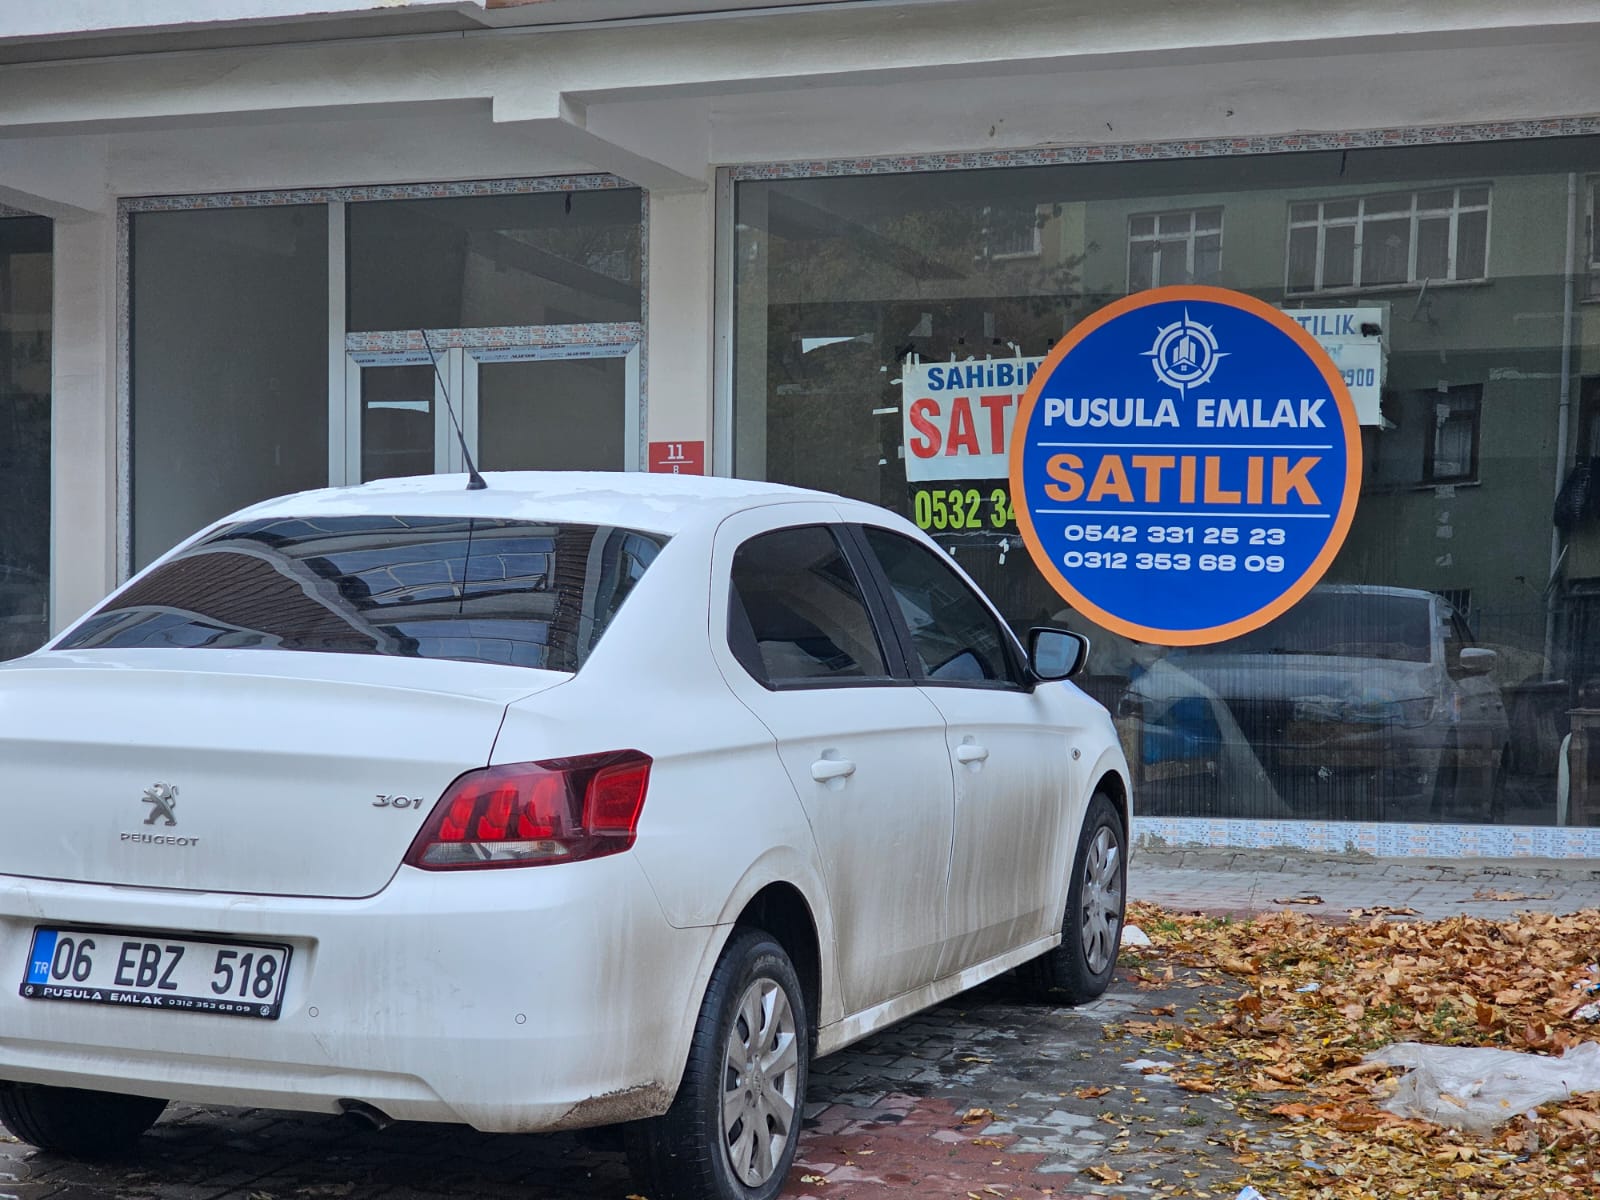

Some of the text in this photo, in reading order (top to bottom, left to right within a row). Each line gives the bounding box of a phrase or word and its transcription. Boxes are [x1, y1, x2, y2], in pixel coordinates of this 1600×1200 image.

[1290, 314, 1355, 336] TILIK
[1044, 398, 1327, 428] PUSULA EMLAK
[909, 394, 1024, 459] SAT
[667, 443, 685, 460] 11
[1044, 453, 1323, 505] SATILIK
[914, 488, 982, 530] 0532
[1064, 524, 1286, 546] 0542 331 25 23
[1063, 551, 1285, 573] 0312 353 68 09
[372, 794, 424, 810] 301
[120, 831, 199, 847] PEUGEOT
[34, 960, 49, 975] TR
[51, 937, 278, 1000] 06 EBZ 518
[43, 987, 163, 1006] PUSULA EMLAK
[168, 998, 251, 1013] 0312 353 68 09
